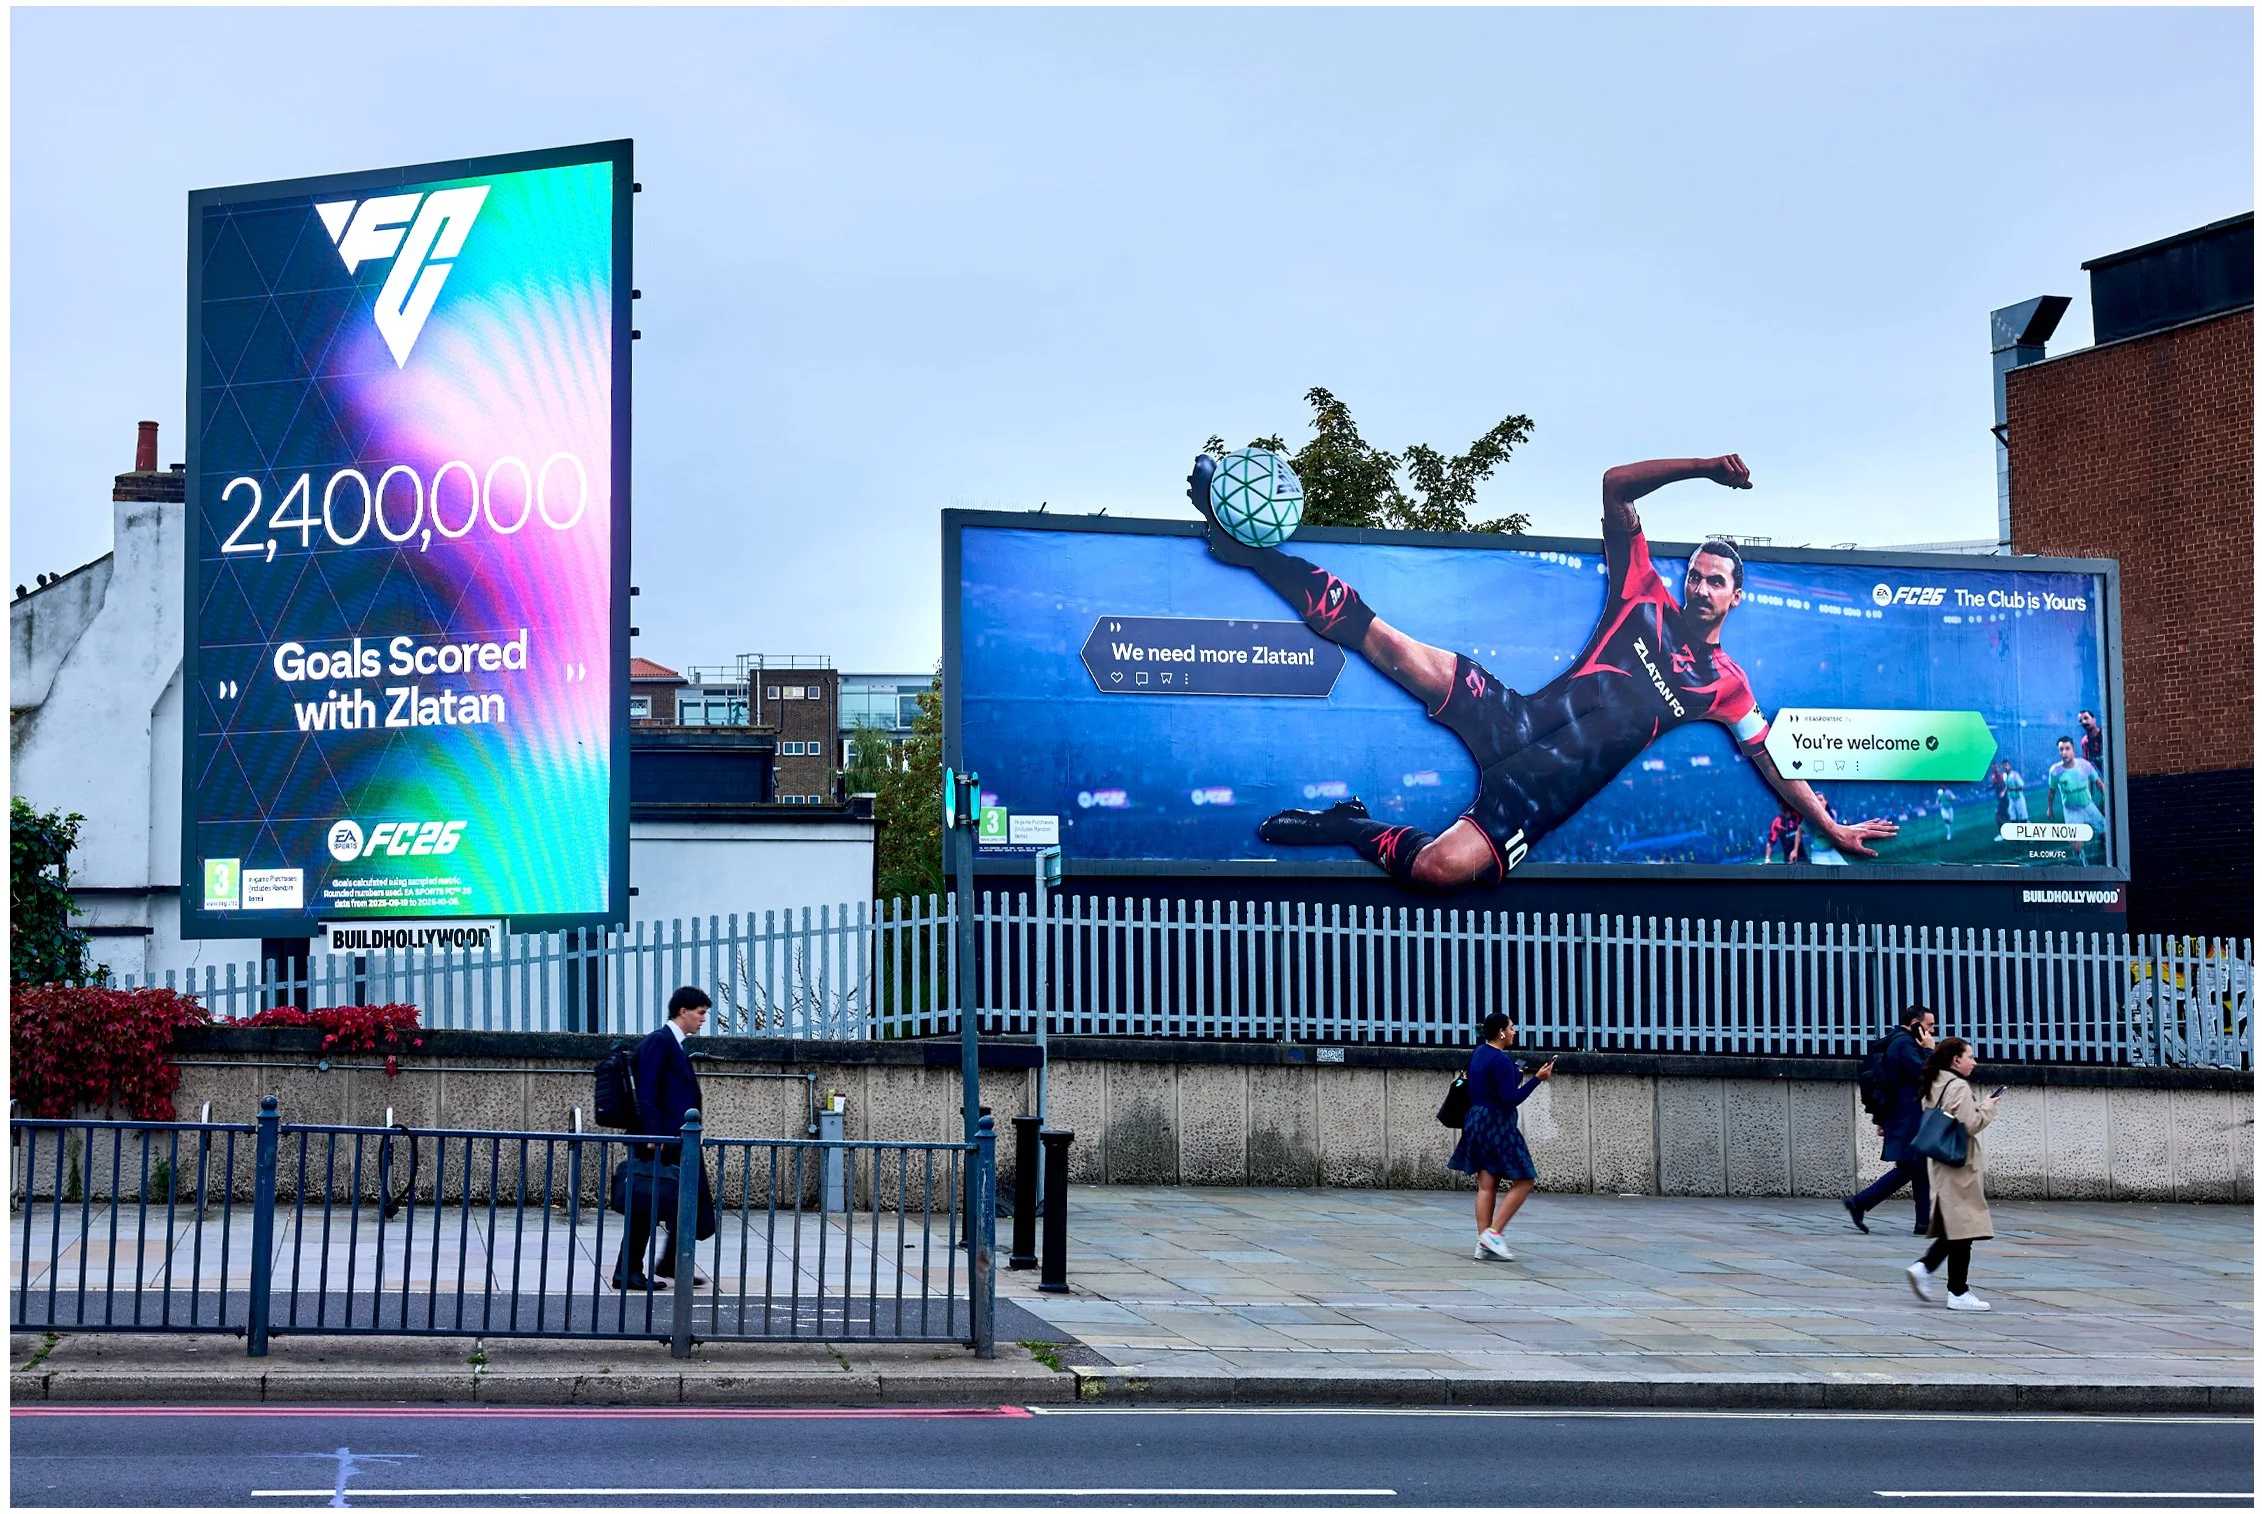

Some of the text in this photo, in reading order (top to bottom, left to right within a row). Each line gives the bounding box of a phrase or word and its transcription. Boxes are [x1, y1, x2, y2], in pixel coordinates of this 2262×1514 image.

[220, 451, 588, 562] 2,400,000
[1892, 586, 2087, 611] FC26 The Club is Yours
[273, 628, 528, 682] Goals Scored
[1111, 642, 1315, 666] We need more Zlatan!
[1632, 637, 1685, 718] ZLATAN FC
[294, 685, 506, 731] with Zlatan
[1847, 734, 1920, 751] welcome
[334, 829, 357, 843] EA
[986, 810, 999, 834] 3
[2016, 825, 2077, 838] PLAY NOW
[362, 820, 468, 857] FC26
[213, 863, 230, 896] 3
